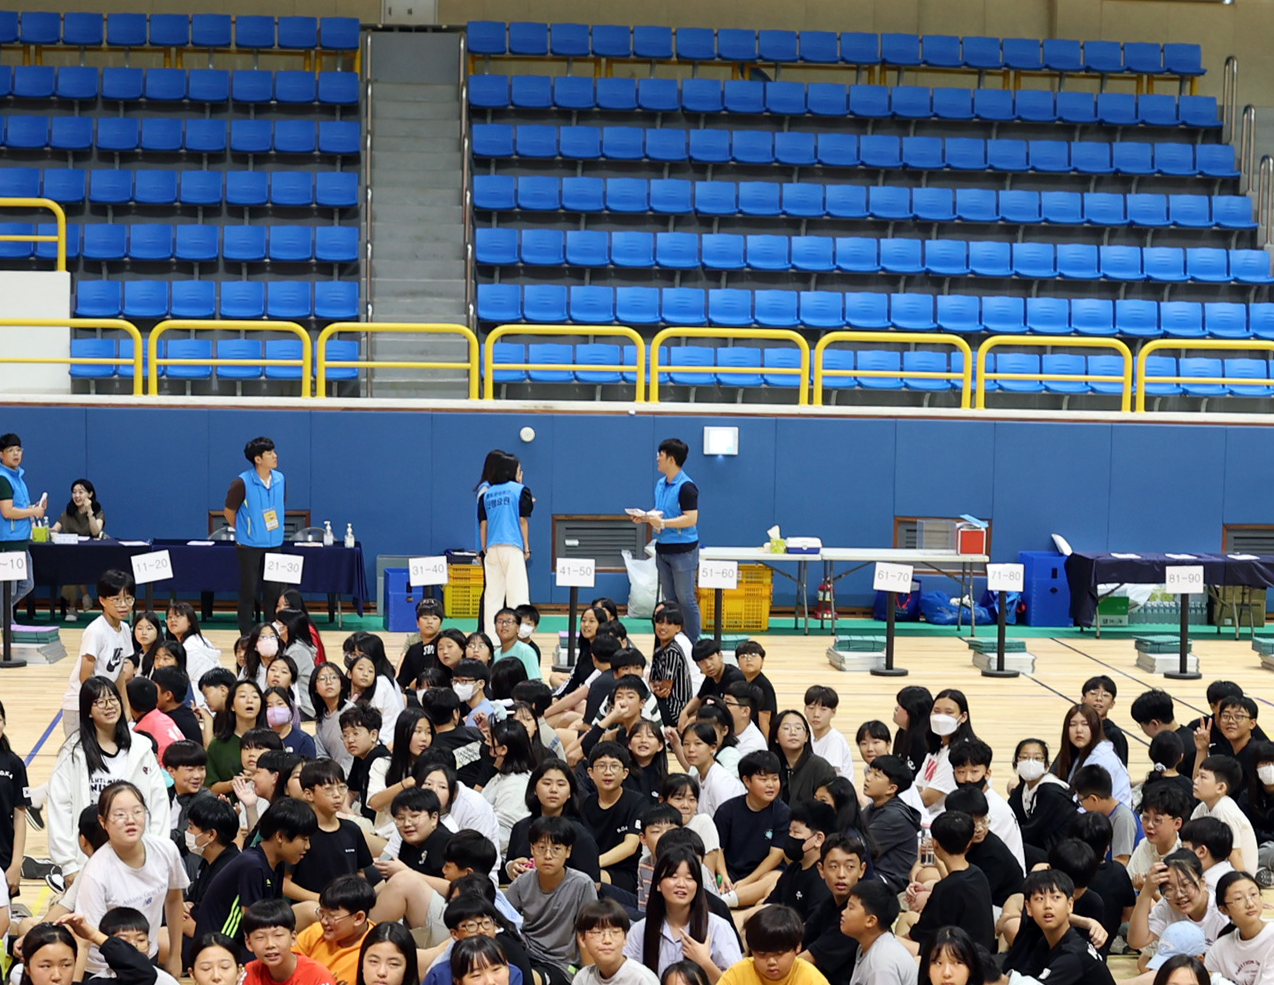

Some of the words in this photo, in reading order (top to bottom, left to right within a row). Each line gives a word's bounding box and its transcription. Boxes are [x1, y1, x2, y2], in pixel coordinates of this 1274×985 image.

[136, 557, 168, 573] 11-20
[267, 560, 300, 573] 21-30
[412, 563, 445, 576] 31-40
[559, 566, 592, 577] 41-50
[701, 565, 734, 578] 51-60
[877, 570, 909, 583] 61-70
[991, 570, 1021, 582] 71-80
[1168, 573, 1201, 584] 81-90
